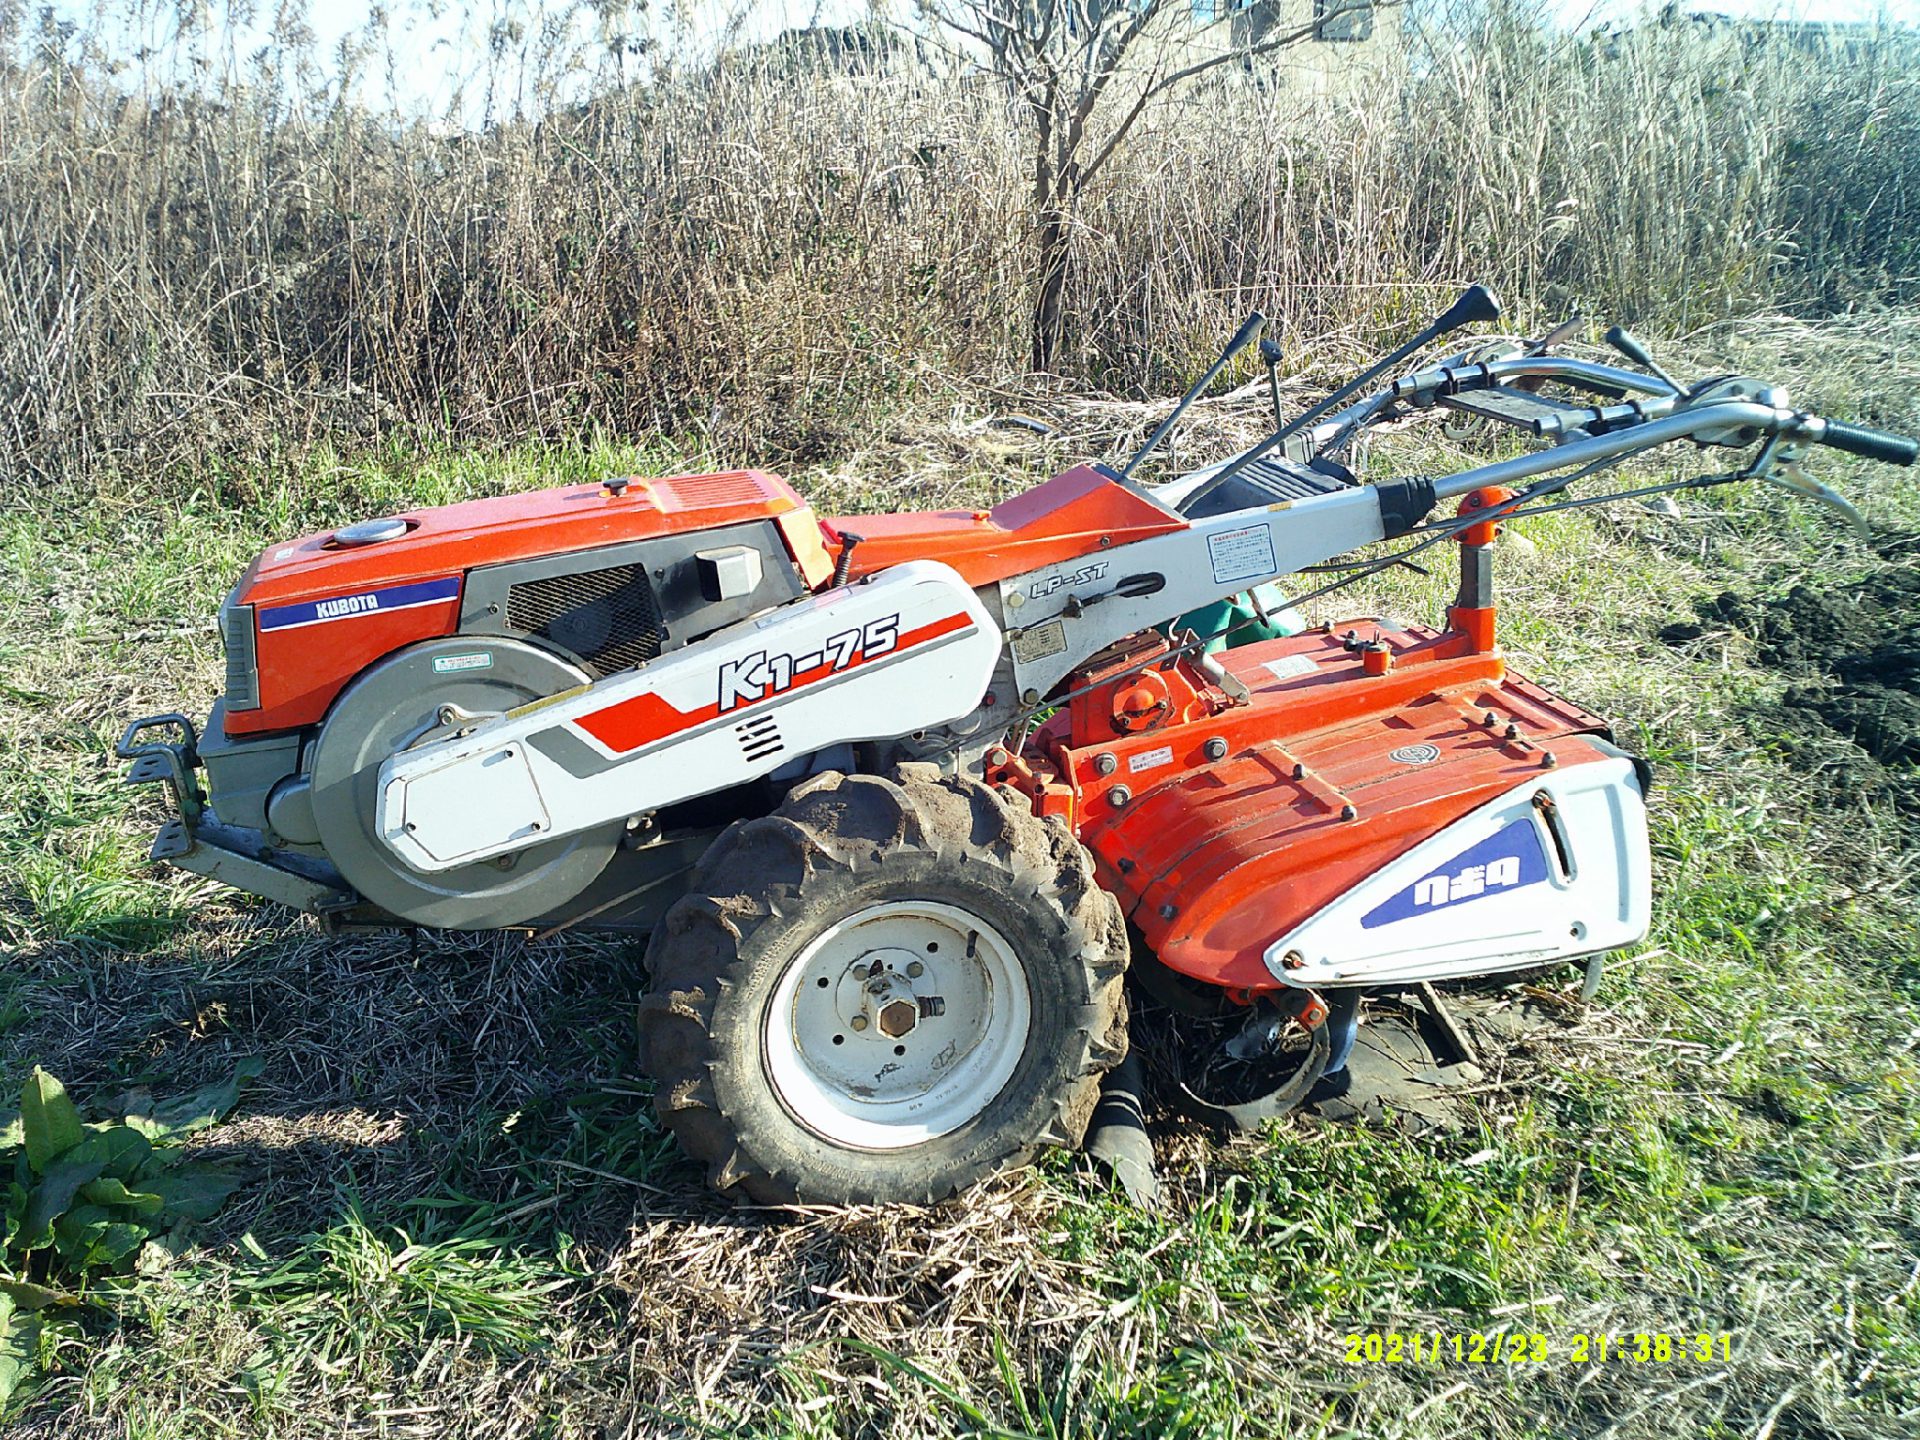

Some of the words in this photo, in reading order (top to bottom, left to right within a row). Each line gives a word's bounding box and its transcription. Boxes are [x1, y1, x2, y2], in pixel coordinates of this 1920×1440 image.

[1030, 561, 1109, 599] LP-ST
[315, 594, 378, 618] KUBOTA
[718, 612, 900, 714] K1-75
[1414, 856, 1520, 906] クボタ
